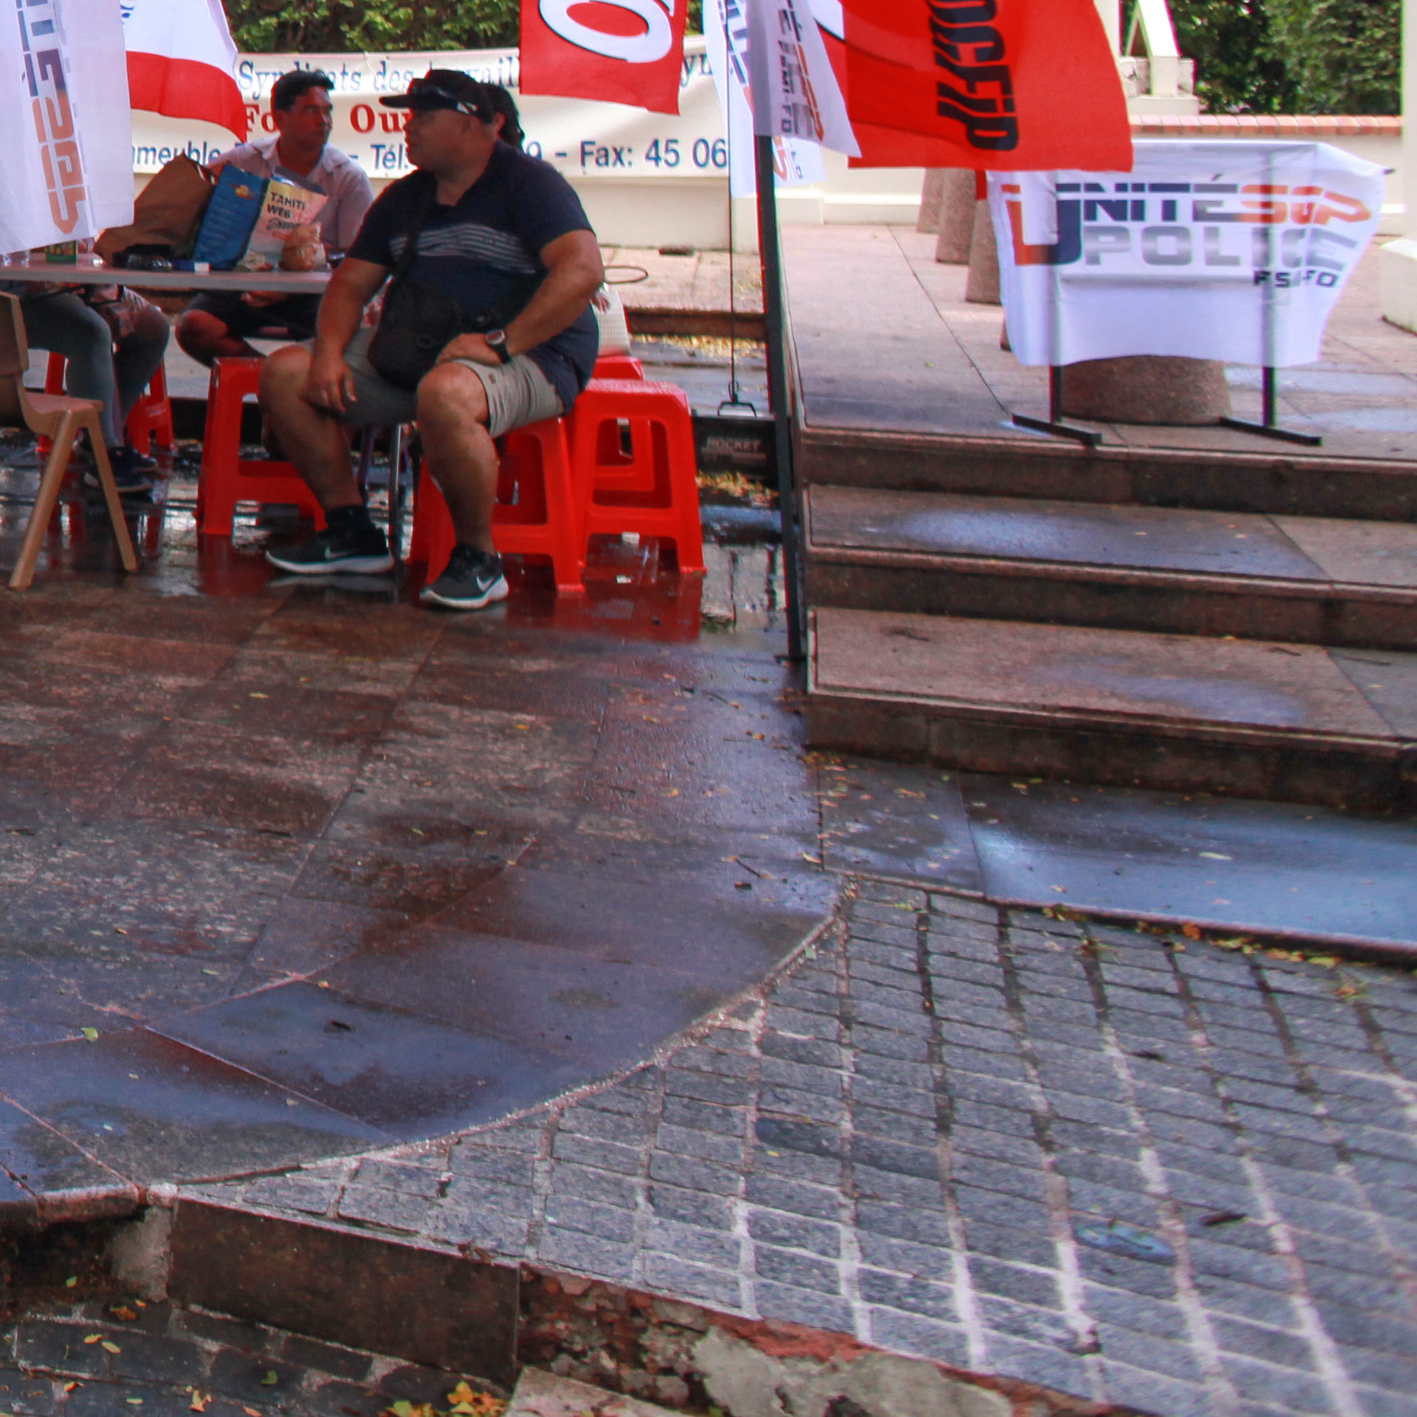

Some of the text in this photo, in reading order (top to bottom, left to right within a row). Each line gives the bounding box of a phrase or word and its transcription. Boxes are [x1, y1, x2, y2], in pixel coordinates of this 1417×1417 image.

[580, 140, 633, 167] Fax:
[645, 138, 680, 167] 45
[692, 138, 727, 168] 06
[1083, 225, 1358, 270] POLICE
